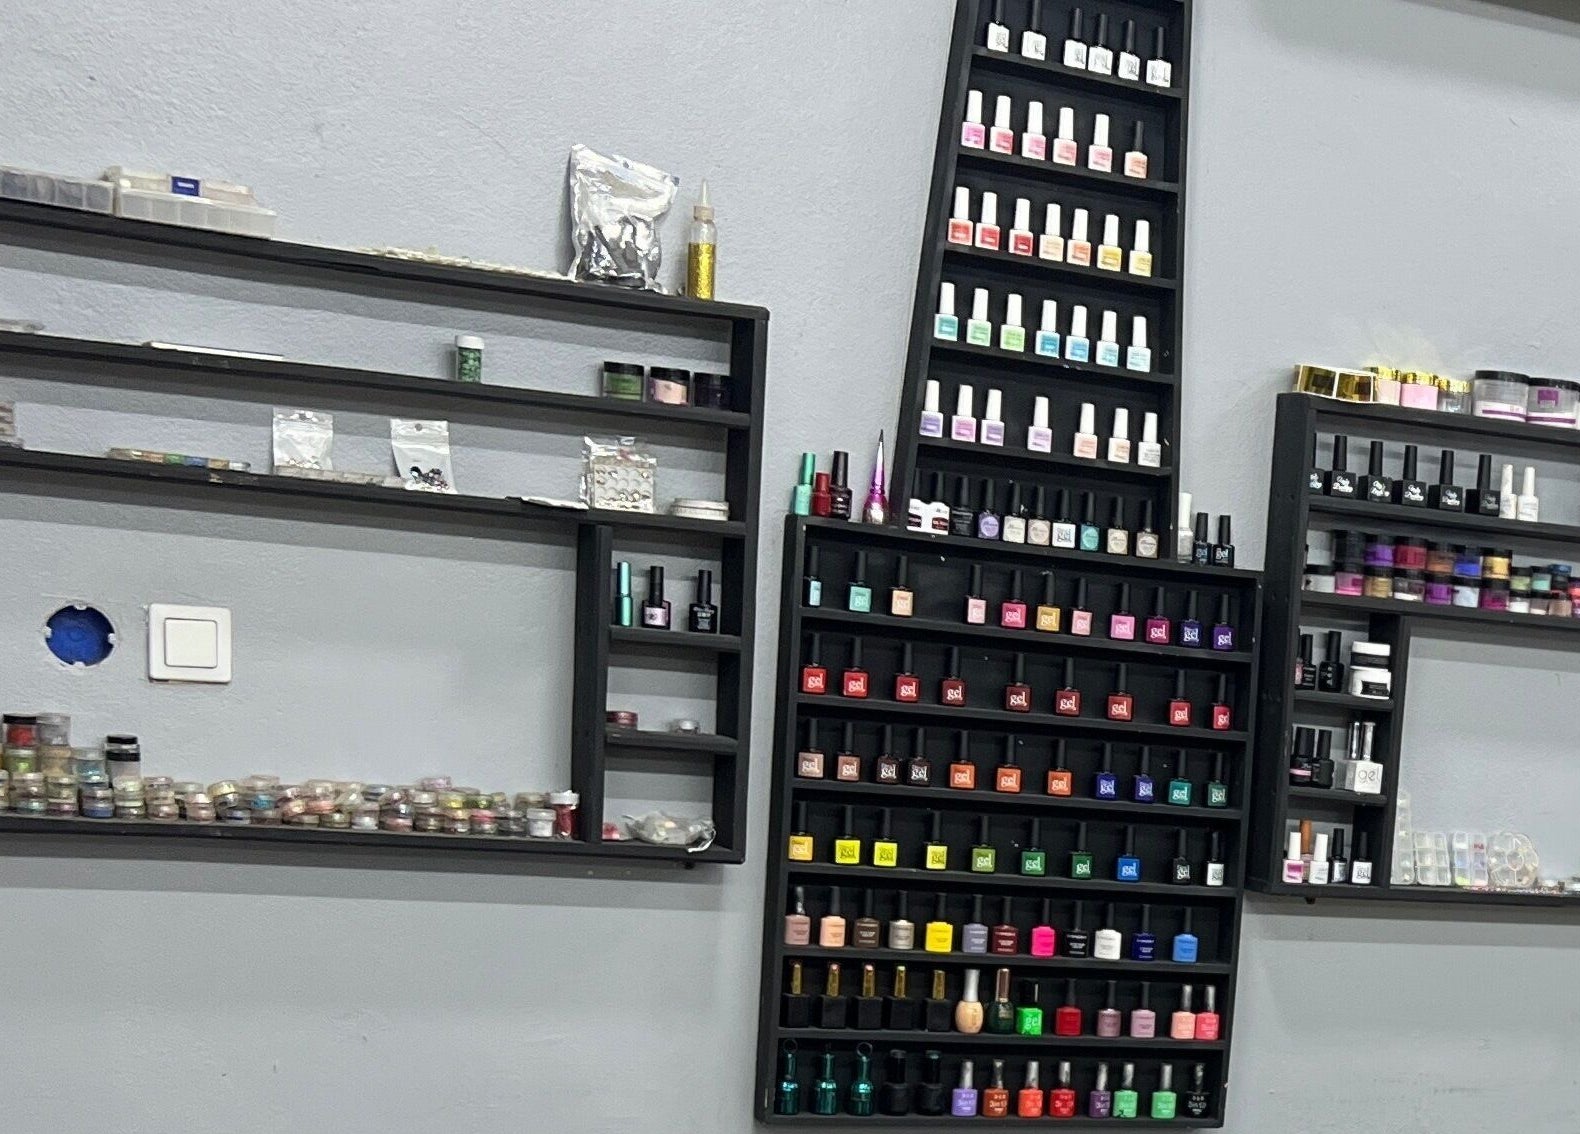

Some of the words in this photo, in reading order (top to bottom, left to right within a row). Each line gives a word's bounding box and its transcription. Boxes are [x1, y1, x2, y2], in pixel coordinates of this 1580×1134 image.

[1005, 608, 1021, 622] gel
[1041, 612, 1057, 626] gel
[1115, 621, 1131, 635] gel
[1150, 625, 1167, 639] gel
[1183, 627, 1200, 642] gel
[1217, 632, 1233, 646] gel
[807, 674, 824, 688] gel
[849, 676, 866, 692] gel
[900, 682, 917, 697] gel
[947, 685, 964, 701] gel
[1010, 692, 1028, 707] gel
[1060, 696, 1077, 711] gel
[1111, 702, 1128, 716] gel
[1174, 707, 1189, 722] gel
[801, 758, 820, 773] gel
[842, 762, 858, 777] gel
[954, 770, 971, 785] gel
[1001, 774, 1018, 788] gel
[1051, 777, 1068, 791] gel
[1100, 780, 1116, 795] gel
[1172, 787, 1189, 801] gel
[976, 853, 993, 869] gel
[1025, 856, 1042, 871] gel
[1076, 860, 1091, 875] gel
[1121, 862, 1138, 877] gel
[1025, 1015, 1041, 1031] gel
